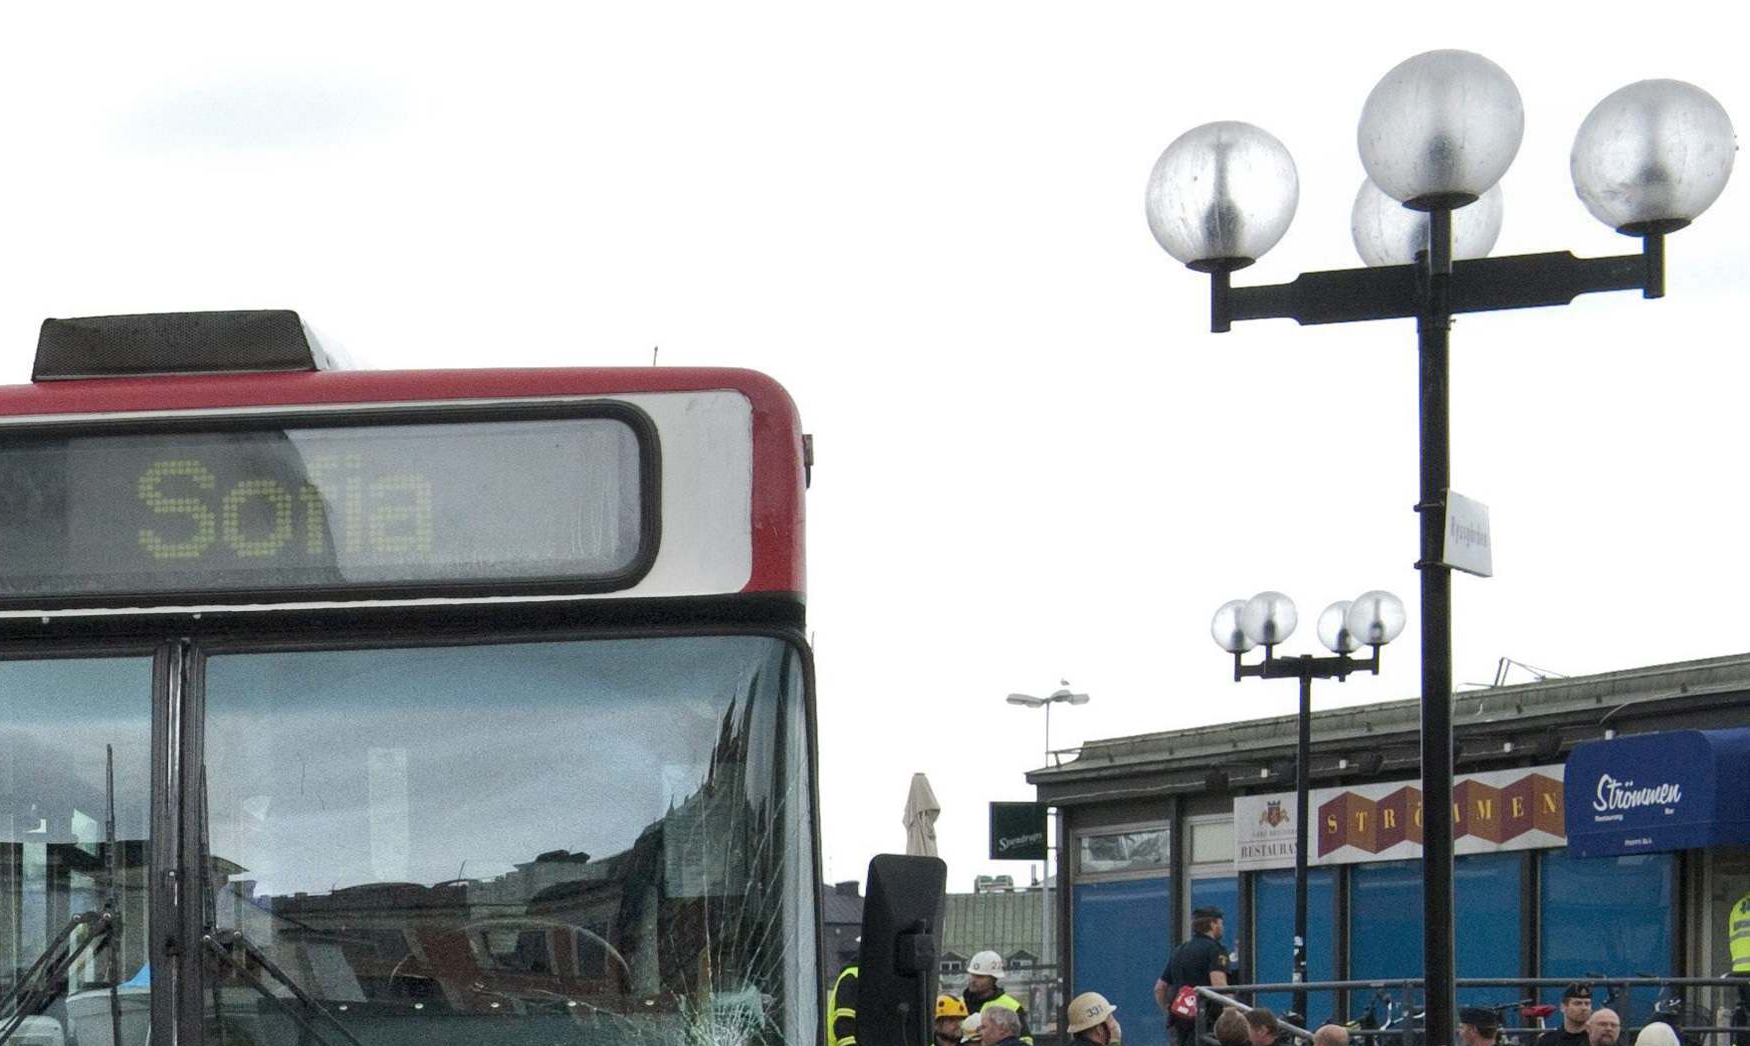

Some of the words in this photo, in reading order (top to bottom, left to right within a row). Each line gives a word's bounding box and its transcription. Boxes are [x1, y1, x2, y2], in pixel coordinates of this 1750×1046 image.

[137, 454, 433, 561] Sofia
[1592, 773, 1682, 812] Strömmen
[1241, 841, 1297, 860] RESTAURA
